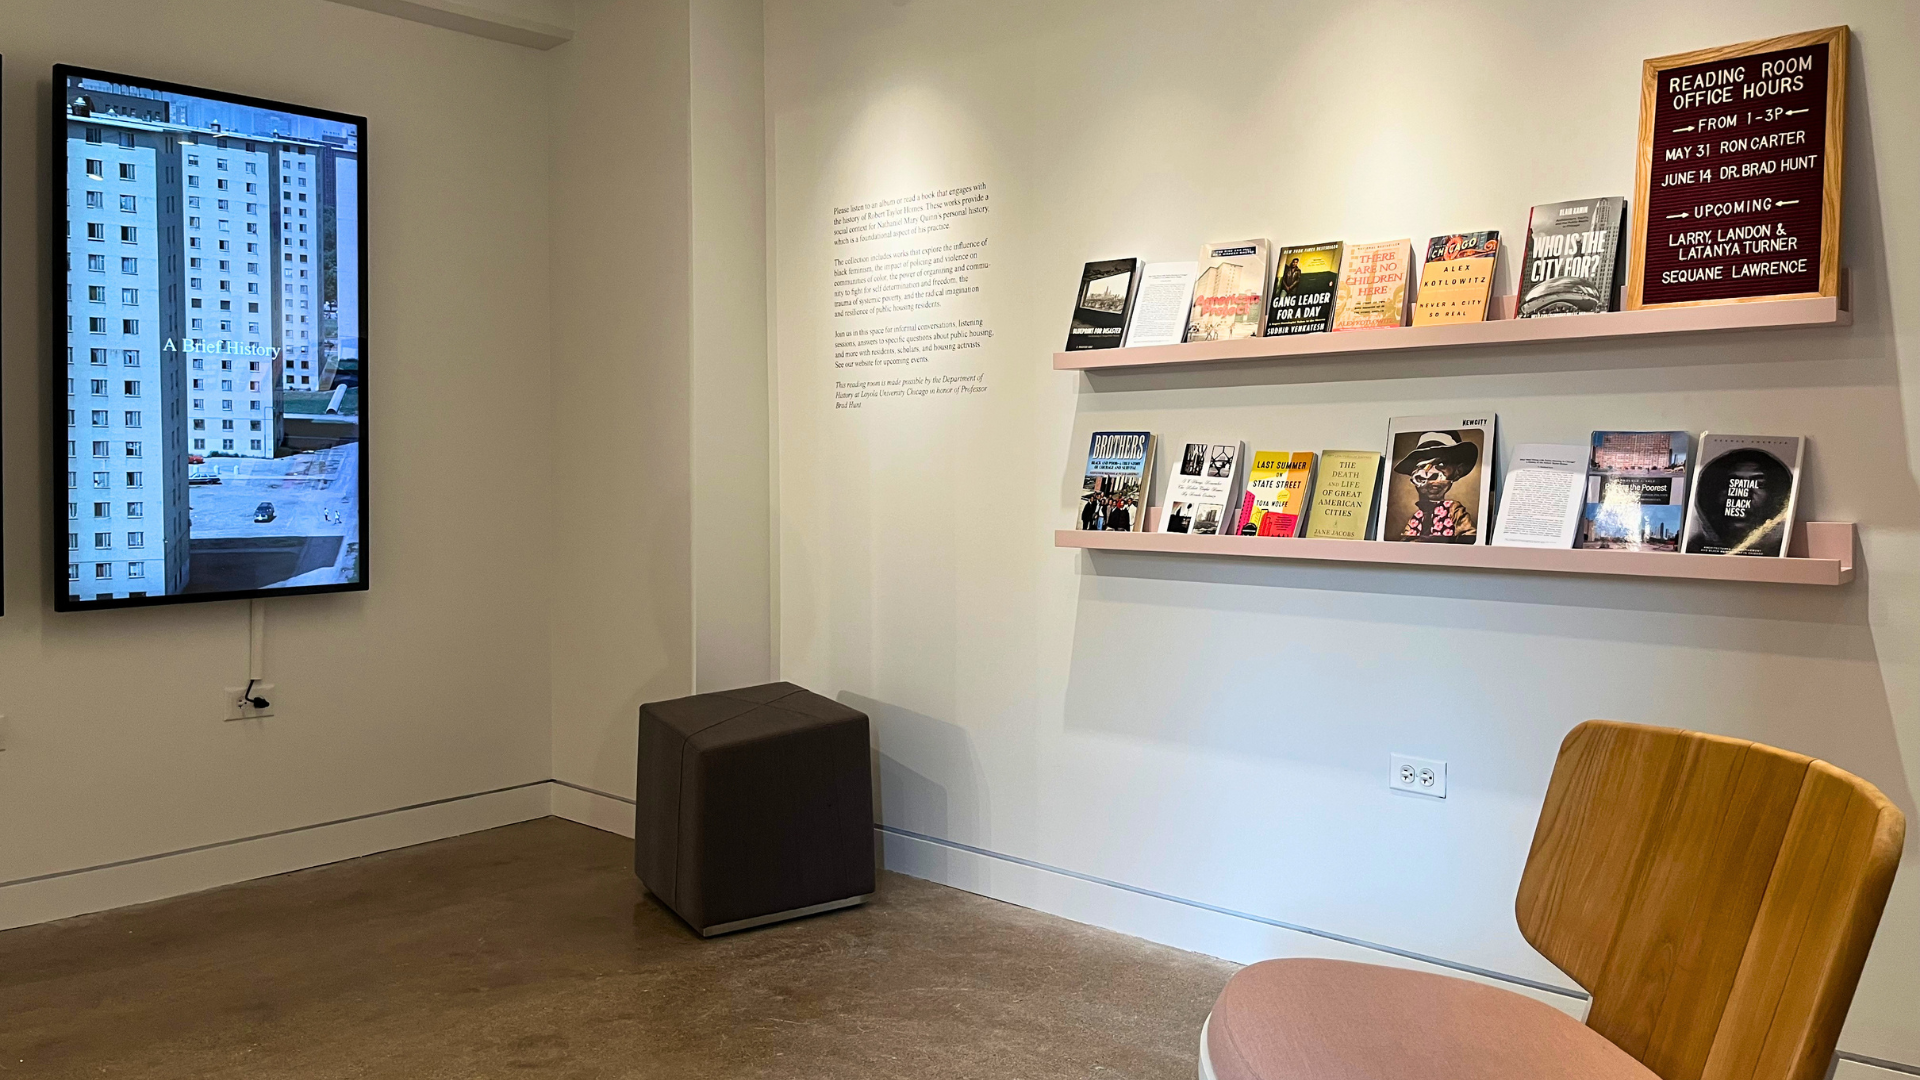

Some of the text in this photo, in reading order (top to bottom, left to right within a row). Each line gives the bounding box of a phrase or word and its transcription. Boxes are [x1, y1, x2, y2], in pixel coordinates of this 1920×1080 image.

[1670, 55, 1812, 93] READING ROOM
[1673, 76, 1804, 110] OFFICE HOURS
[1698, 114, 1737, 132] FROM
[1666, 130, 1805, 161] MAY 31 RON CARTER
[1662, 171, 1695, 187] JUNE
[1700, 169, 1712, 183] 14
[1742, 160, 1776, 177] BRAD
[1781, 155, 1817, 172] HUNT
[1694, 198, 1772, 218] UPCOMING
[1669, 223, 1786, 246] LARRY, LANDON &
[1432, 238, 1476, 258] CHICAGO
[1533, 231, 1607, 258] WHO IS THE
[1678, 237, 1797, 261] LATANYA TURNER
[1360, 252, 1395, 263] THERE
[1354, 263, 1397, 274] ARE NO
[1531, 255, 1600, 282] CITY FOR?
[1662, 258, 1807, 284] SEQUANE LAWRENCE
[1346, 273, 1404, 285] CHILDREN
[1424, 277, 1486, 287] KOTLOWITZ
[1358, 286, 1388, 296] HERE
[1196, 294, 1260, 307] American
[1273, 292, 1330, 308] GANG LEADER
[845, 308, 868, 316] resilience
[870, 306, 875, 314] of
[876, 306, 891, 315] public
[893, 304, 914, 312] housing
[1201, 304, 1250, 318] Project
[1277, 306, 1321, 320] FOR A DAY
[894, 324, 916, 332] informal
[959, 320, 983, 328] listening
[1267, 323, 1325, 335] SUDHIR VENKATESH
[885, 336, 904, 345] specific
[906, 335, 932, 344] questions
[934, 332, 948, 340] about
[950, 331, 967, 340] public
[163, 338, 280, 360] A Brief History
[934, 343, 956, 351] housing
[883, 358, 909, 366] upcoming
[847, 381, 866, 389] reading
[902, 377, 923, 386] possible
[925, 376, 930, 385] by
[943, 375, 976, 384] Department
[977, 373, 984, 382] of
[861, 391, 878, 399] Loyola
[907, 388, 928, 396] Chicago
[954, 386, 960, 395] of
[961, 385, 987, 394] Professor
[1092, 435, 1145, 459] BROTHERS
[1253, 480, 1301, 489] STATE STREET
[1729, 479, 1759, 489] SPATIAL
[1335, 490, 1362, 498] GREAT
[1728, 488, 1749, 497] IZING
[1318, 499, 1362, 507] AMERICAN
[1726, 499, 1751, 508] BLACK
[1325, 509, 1352, 517] CITIES
[1724, 508, 1746, 517] NESS
